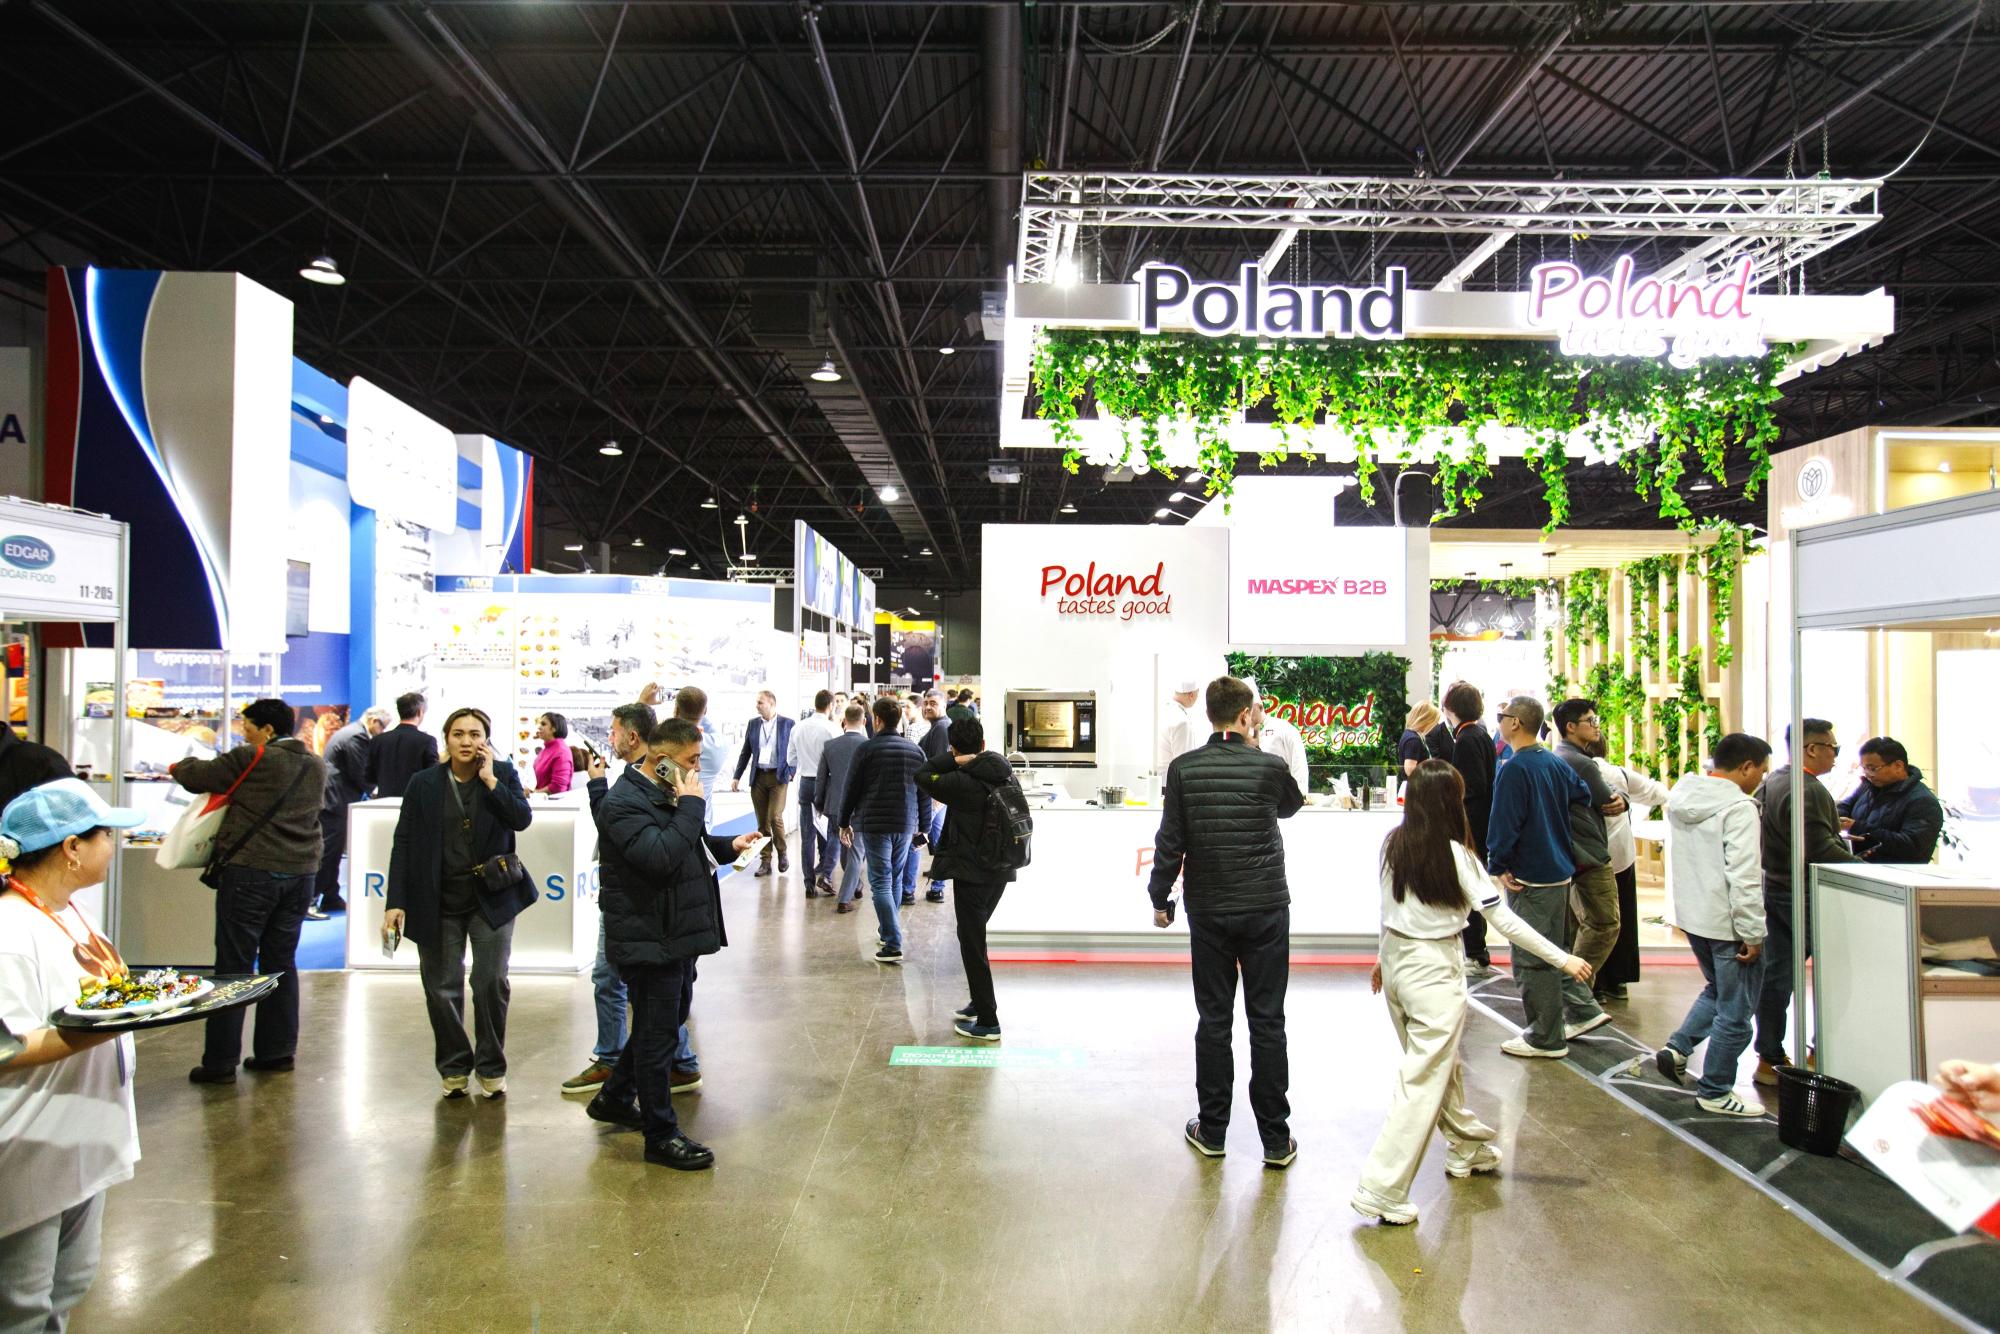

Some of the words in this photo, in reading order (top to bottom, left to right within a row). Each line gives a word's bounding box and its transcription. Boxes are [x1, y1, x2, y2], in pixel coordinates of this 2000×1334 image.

[1144, 265, 1404, 335] Poland
[1535, 257, 1752, 320] Poland
[4, 543, 50, 561] EDGAR
[0, 568, 28, 580] DGAR
[30, 571, 57, 583] FOOD
[1041, 561, 1163, 597] Poland
[1247, 576, 1339, 595] MASPEX
[1343, 579, 1387, 595] B2B
[79, 584, 113, 600] 11-205
[1057, 596, 1116, 614] tastes
[1120, 594, 1171, 620] good
[1299, 728, 1327, 744] tes
[1330, 724, 1383, 751] good
